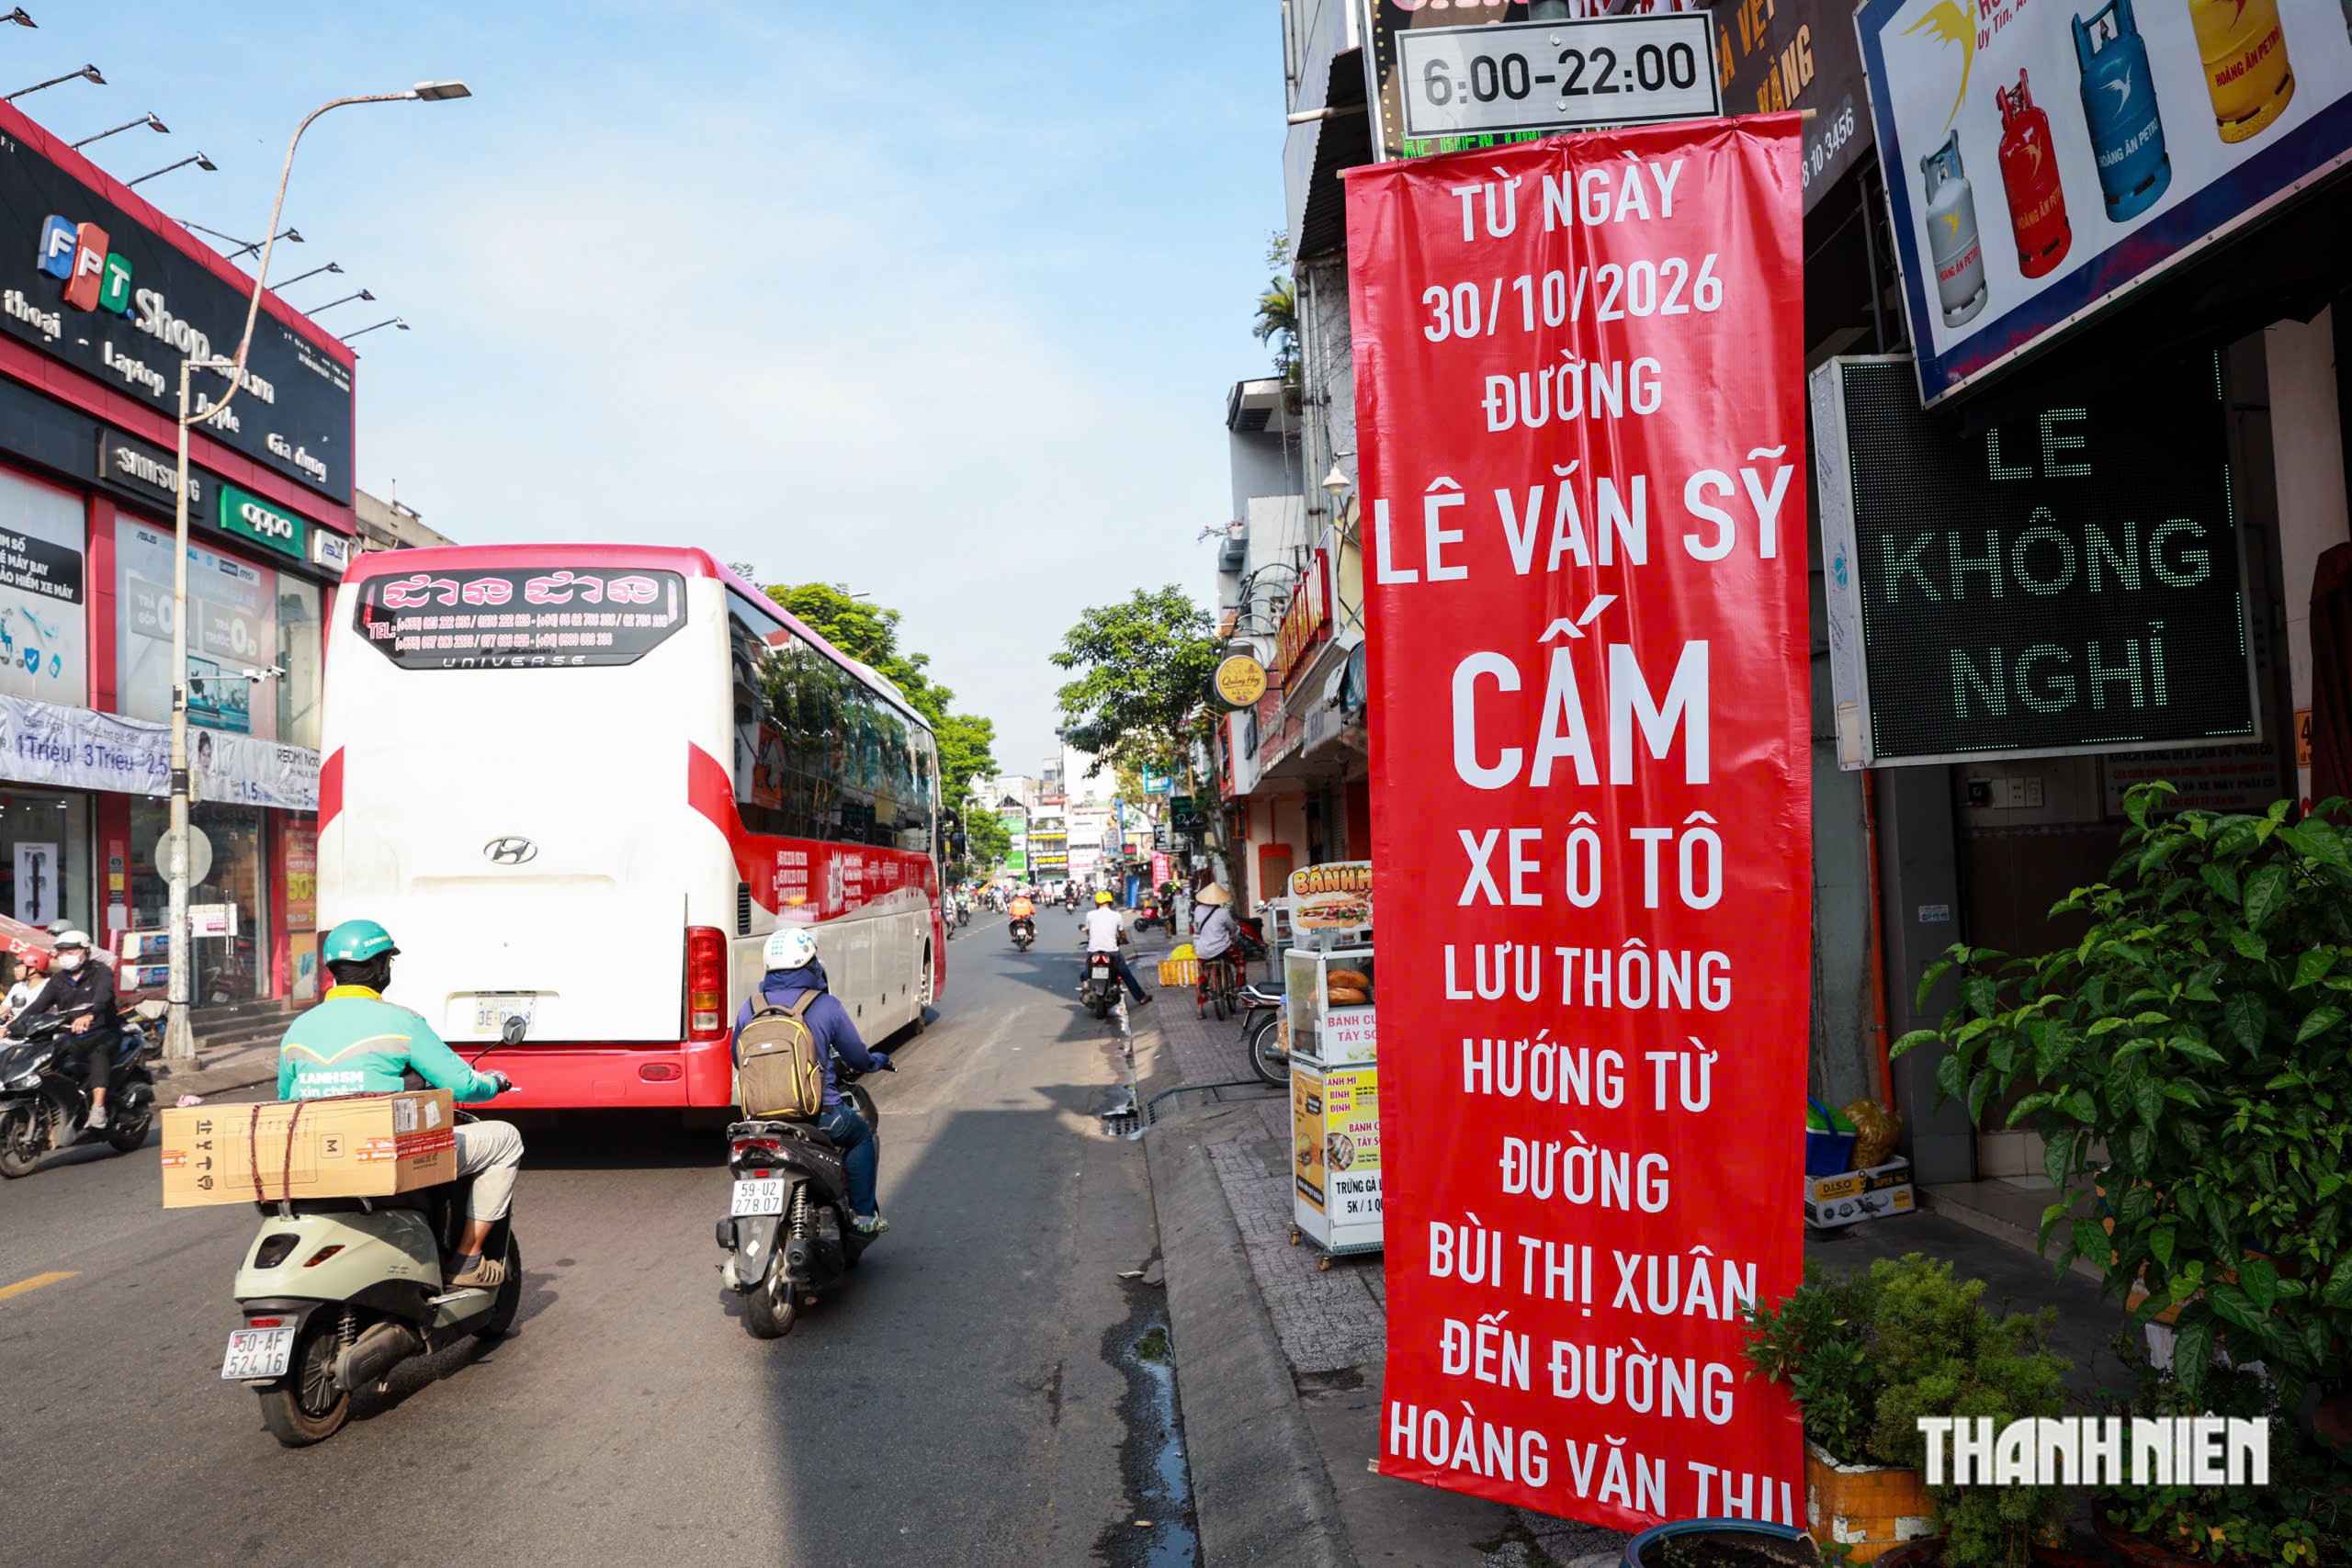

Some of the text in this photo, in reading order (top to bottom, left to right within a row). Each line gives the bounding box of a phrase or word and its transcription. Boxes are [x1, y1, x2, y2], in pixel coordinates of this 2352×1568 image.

[1423, 42, 1696, 107] 6:00-22:00
[2215, 26, 2280, 87] HOÀNG ÂN PETRO
[1811, 143, 1824, 176] 10
[1825, 107, 1854, 161] 3456
[1452, 149, 1683, 243] TỪ NGÀY
[4, 288, 62, 343] thoại
[1422, 254, 1724, 343] 30/10/2026
[104, 341, 166, 397] Laptop
[1481, 349, 1662, 432] ĐƯỜNG
[267, 433, 327, 483] Gia dụng
[11, 536, 26, 552] SỐ
[1374, 446, 1794, 585] LÊ VĂN SỸ
[7, 554, 28, 570] MÁY
[29, 560, 49, 576] BAY
[1882, 506, 2211, 604] KHÔNG
[16, 570, 39, 591] HIỂM
[40, 580, 53, 594] XE
[54, 583, 74, 599] MÁY
[369, 621, 396, 640] TEL:
[443, 655, 586, 668] UNIVERSE
[1951, 621, 2167, 717] NGHỈ
[1452, 594, 1711, 789] CẤM
[27, 736, 71, 768] Triệu
[85, 744, 93, 767] 3
[96, 745, 134, 775] Triệu
[147, 752, 168, 776] 2.5
[1293, 865, 1373, 895] BÁNH M
[1457, 810, 1723, 910] XE Ô TÔ
[1444, 938, 1732, 1011] LƯU THÔNG
[1328, 1014, 1359, 1028] BÁNH
[1338, 1029, 1360, 1042] TÂY
[300, 1087, 321, 1099] xin
[1463, 1028, 1718, 1112] HƯỚNG TỪ
[1336, 1178, 1363, 1194] TRỨNG
[1499, 1130, 1669, 1213] ĐƯỜNG
[735, 1197, 779, 1213] 278.07
[1348, 1200, 1358, 1213] 5K
[1368, 1200, 1372, 1212] 1
[1429, 1213, 1757, 1323] BÙI THỊ XUÂN
[229, 1353, 284, 1375] 524.16
[1440, 1311, 1734, 1425] ĐẾN ĐƯỜNG
[1390, 1400, 1548, 1487] HOÀNG
[1566, 1434, 1667, 1517] VĂN
